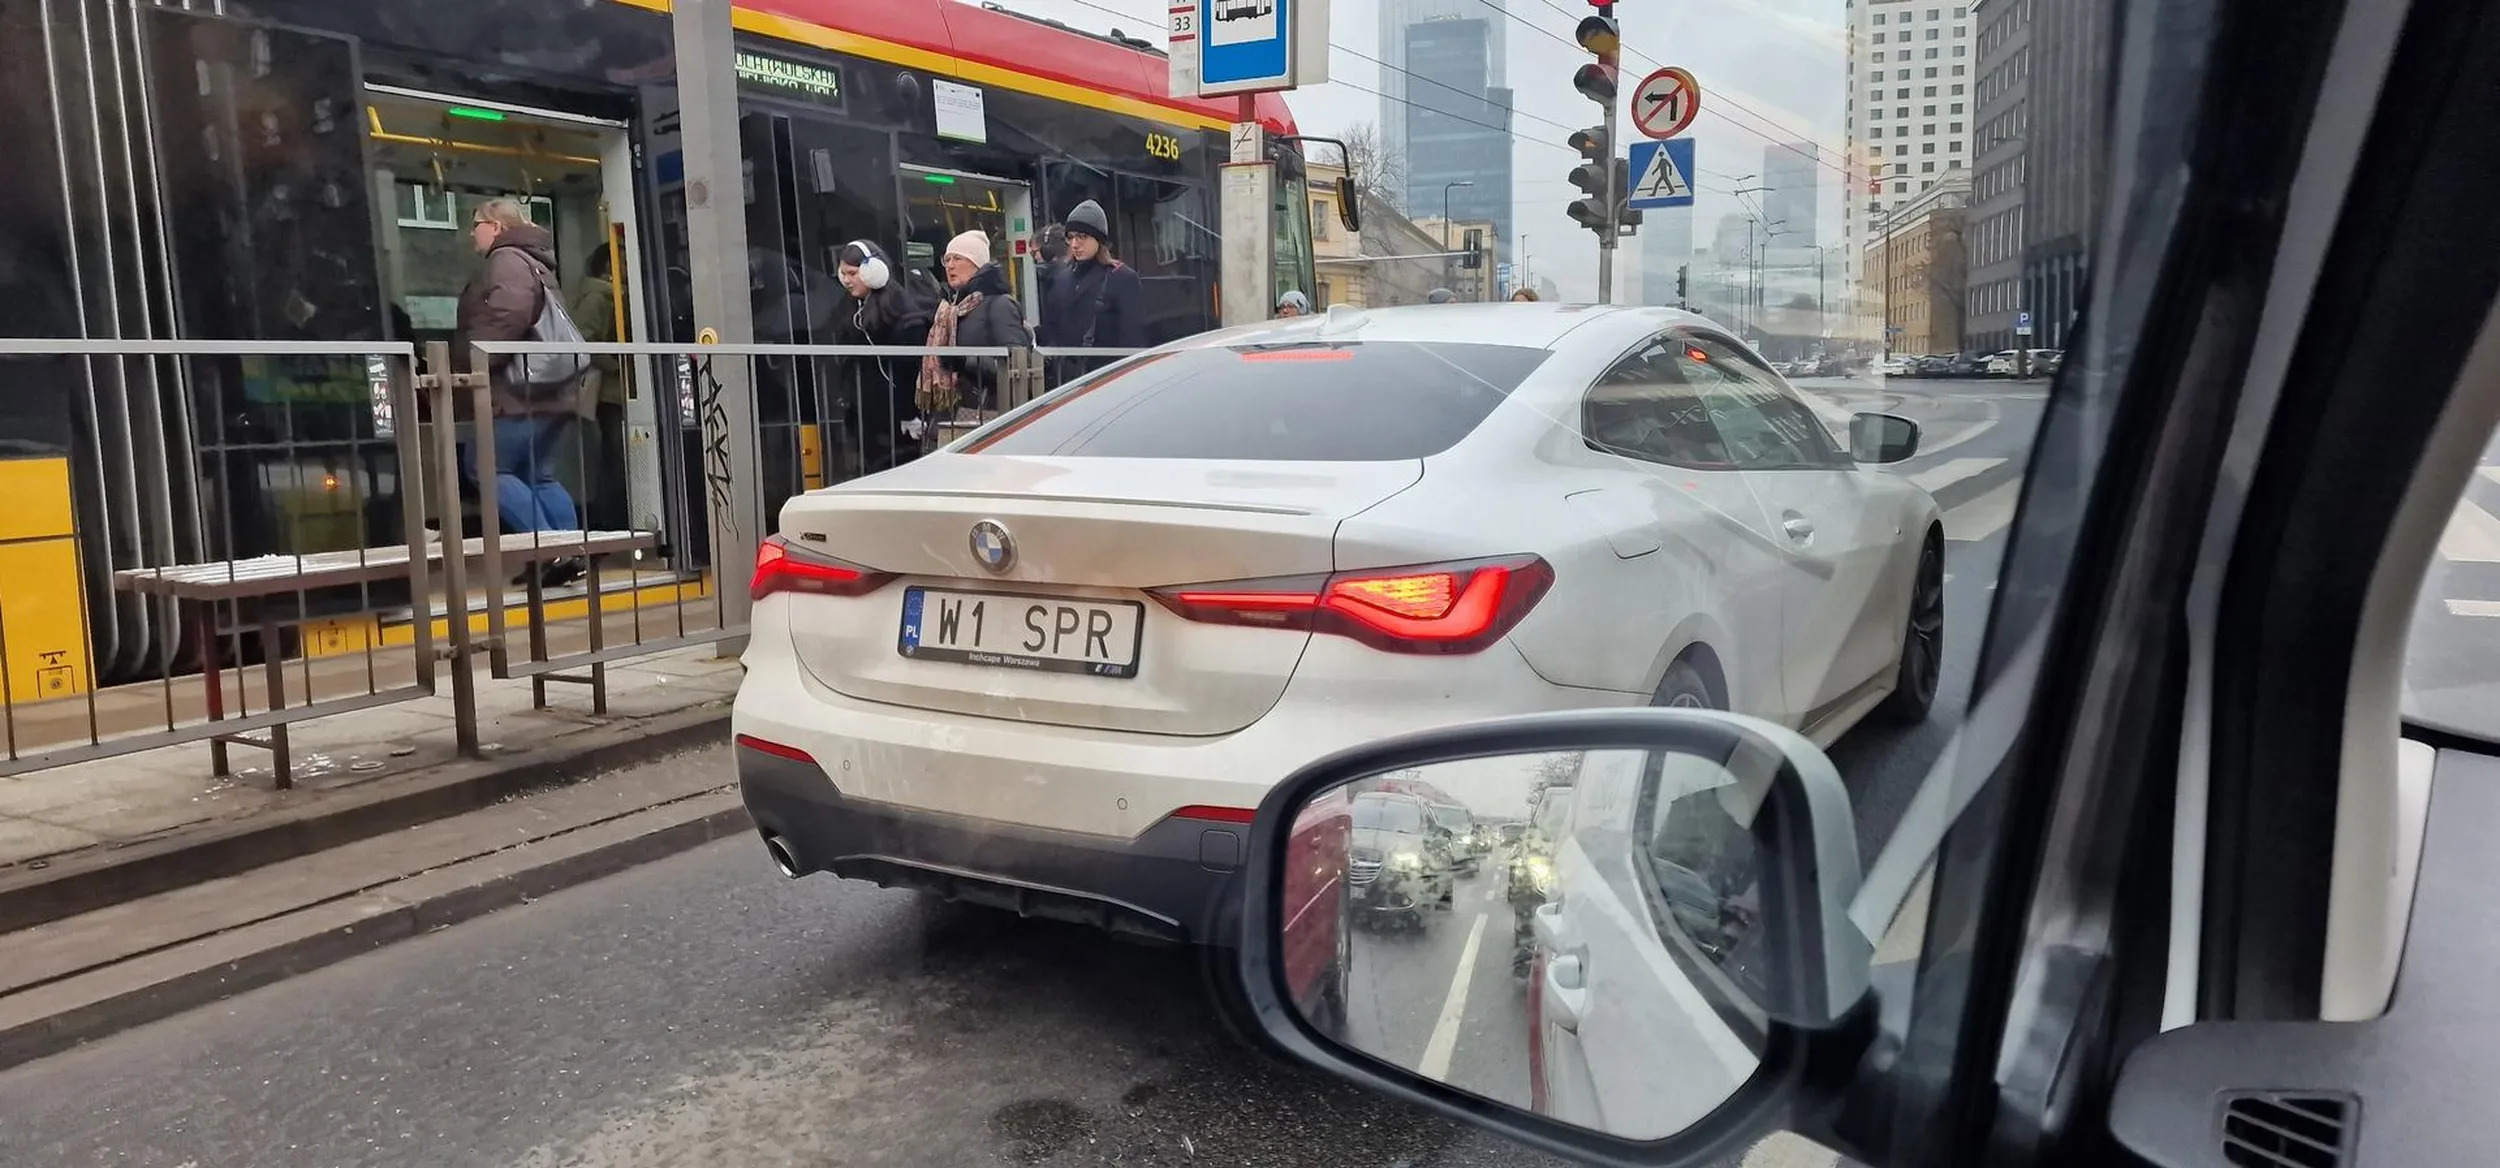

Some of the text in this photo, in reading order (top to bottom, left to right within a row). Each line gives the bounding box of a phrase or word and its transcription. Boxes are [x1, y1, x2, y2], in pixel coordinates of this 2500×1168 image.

[1174, 16, 1190, 31] 33
[1146, 133, 1179, 160] 4236
[2020, 312, 2029, 324] P
[906, 625, 918, 638] PL
[938, 598, 1113, 659] W1 SPR
[968, 652, 1040, 667] Inchcape Warszawa
